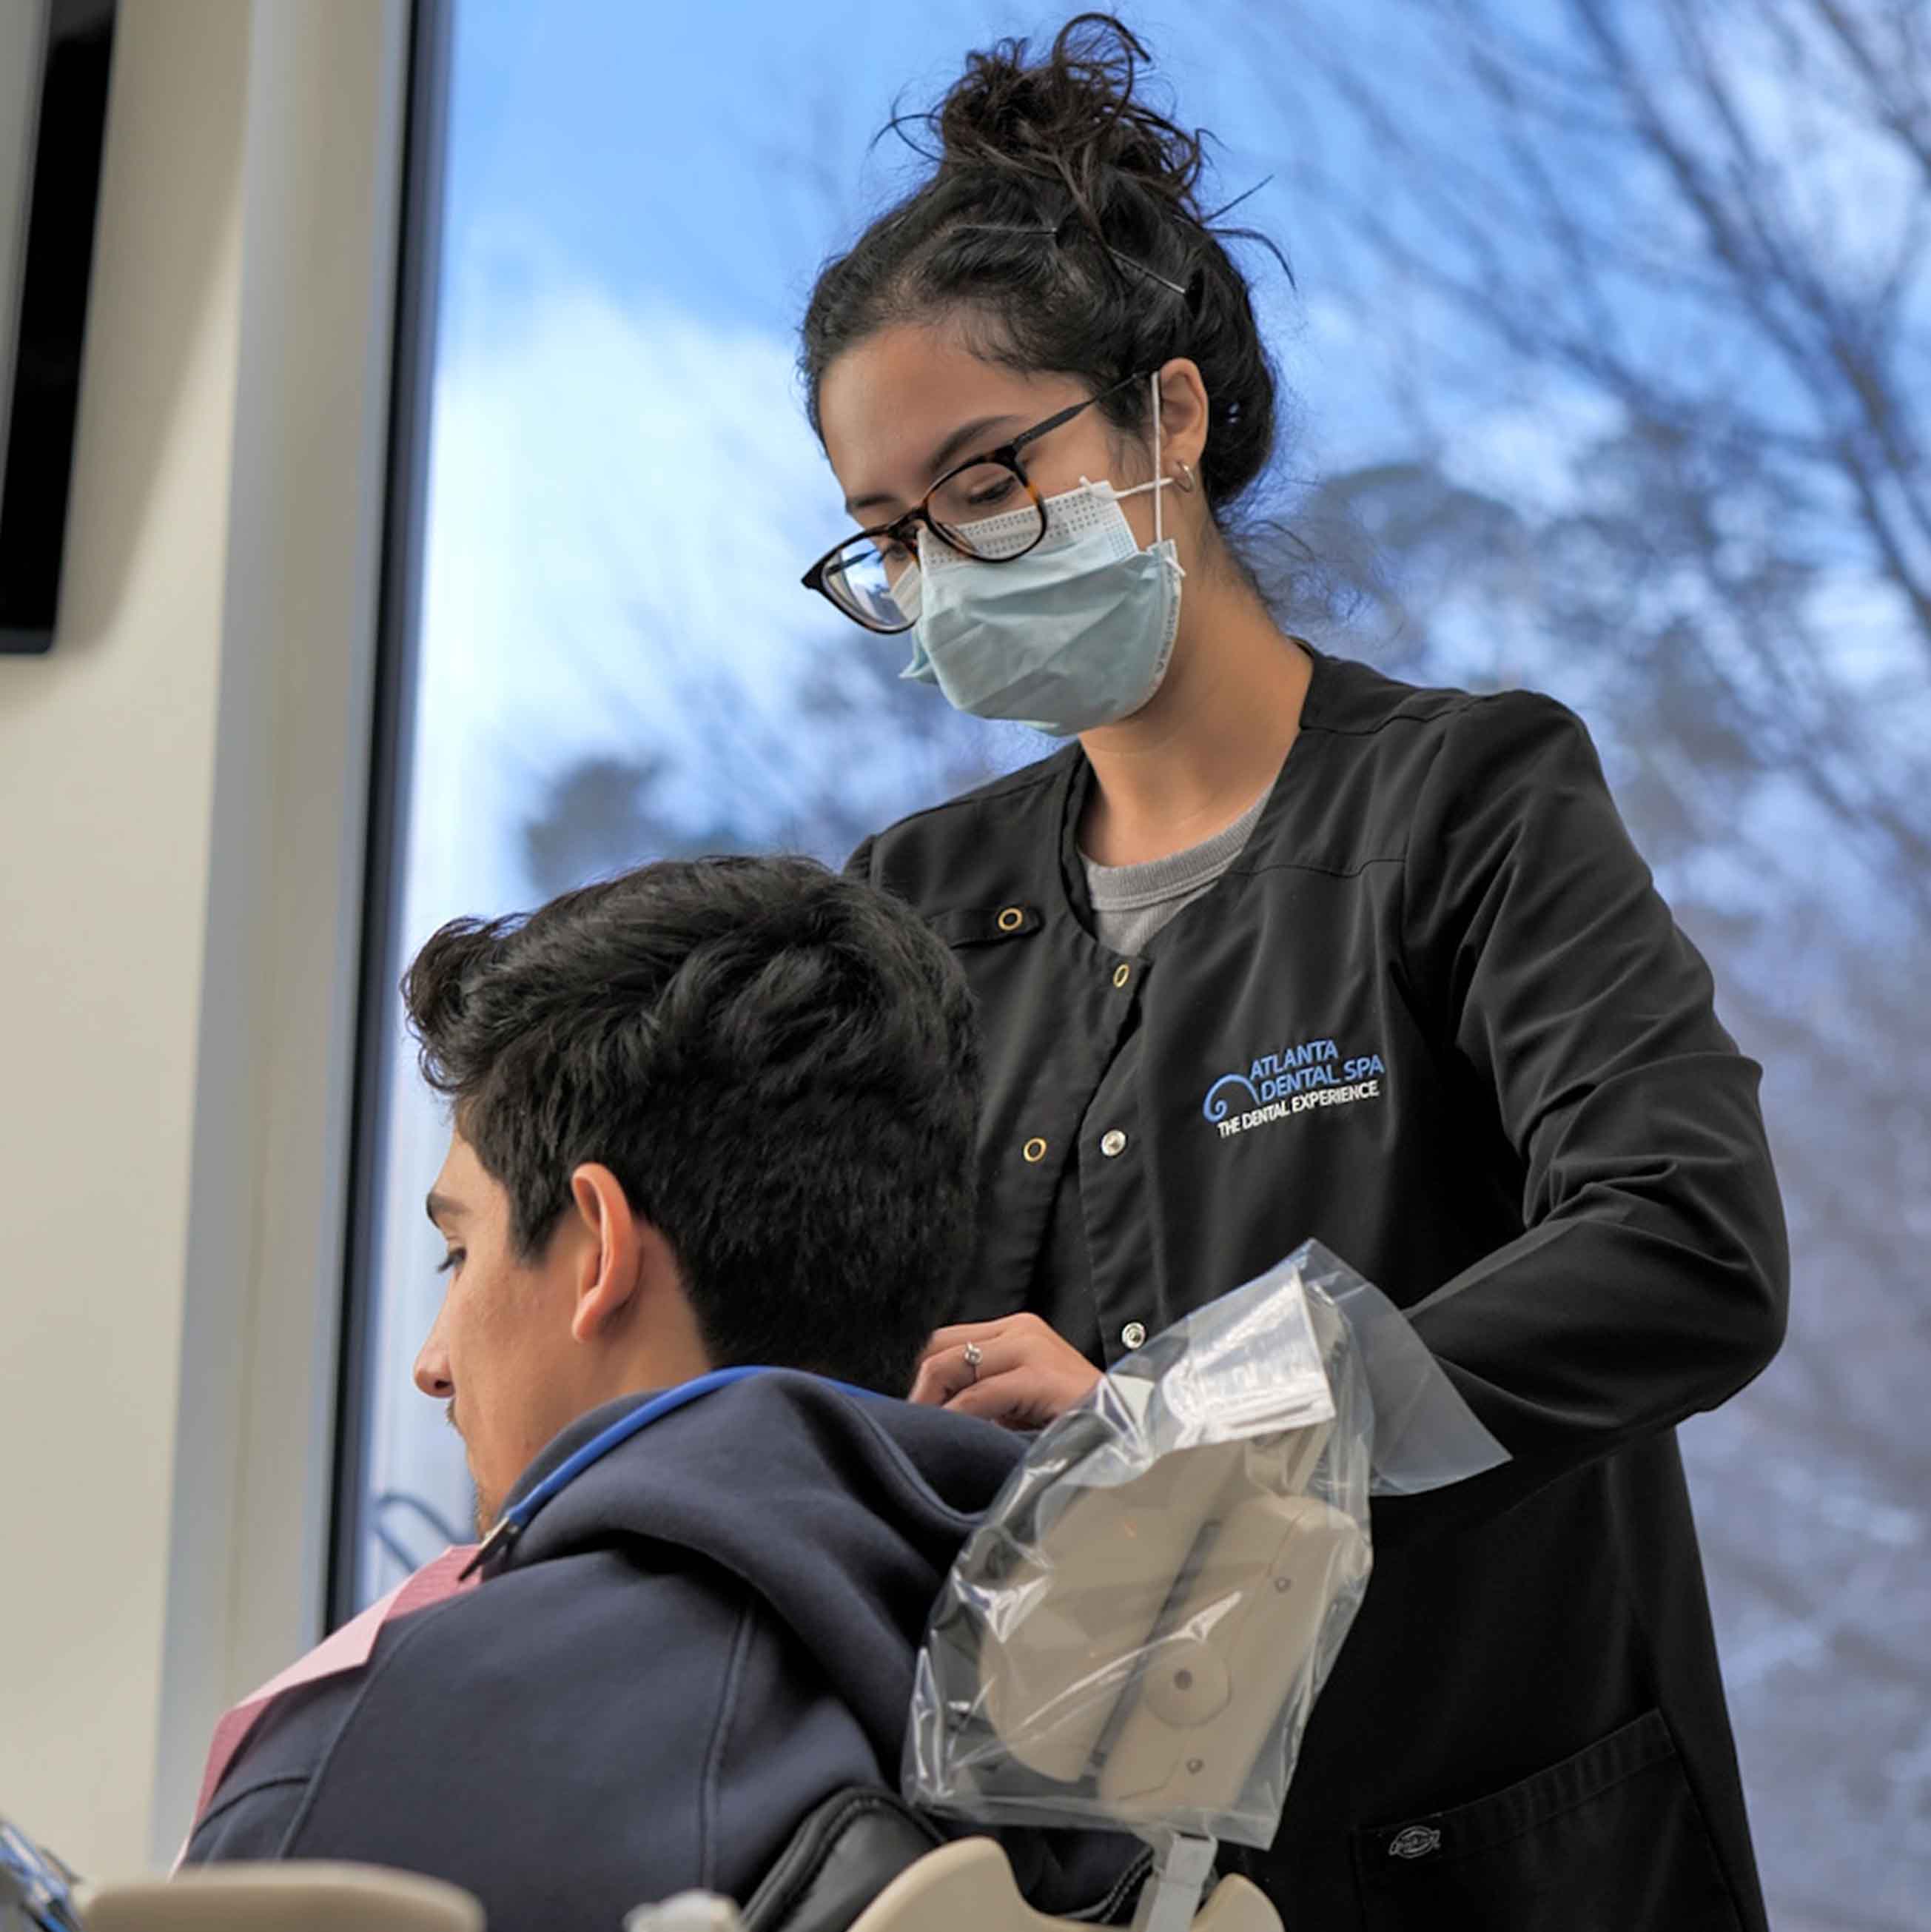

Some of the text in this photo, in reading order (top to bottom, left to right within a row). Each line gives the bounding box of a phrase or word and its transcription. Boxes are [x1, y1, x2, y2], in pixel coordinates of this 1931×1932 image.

[1249, 1039, 1338, 1080] ATLANTA
[1260, 1054, 1386, 1102] DENTAL SPA
[1217, 1080, 1380, 1138] THE DENTAL EXPERIENCE
